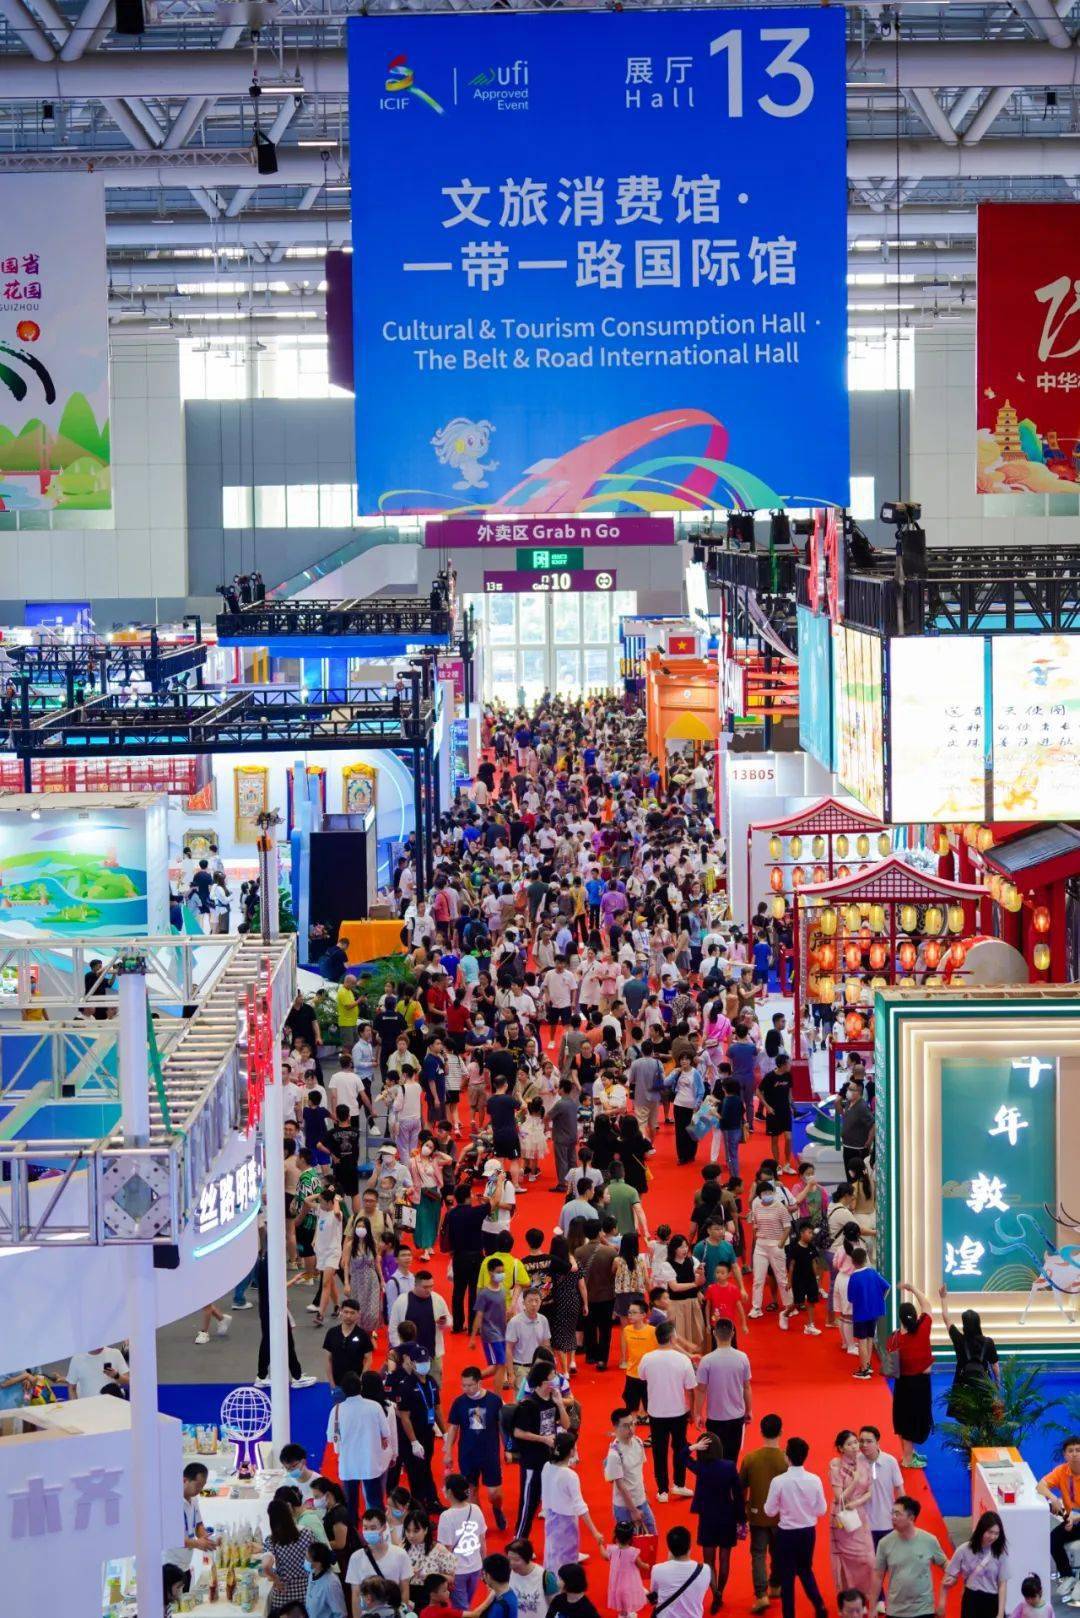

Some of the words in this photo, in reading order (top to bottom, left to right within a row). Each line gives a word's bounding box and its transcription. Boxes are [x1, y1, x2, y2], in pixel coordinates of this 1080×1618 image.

[497, 60, 529, 86] ufi
[625, 56, 693, 84] 展厅
[710, 28, 813, 117] 13
[380, 98, 410, 110] ICIF
[473, 89, 529, 103] Approved
[497, 99, 529, 111] Event
[625, 88, 695, 109] Hall
[403, 235, 797, 292] 一带一路国际馆
[382, 319, 474, 341] Cultural
[479, 319, 496, 340] &
[501, 318, 595, 339] Tourism
[601, 314, 755, 341] Consumption
[762, 311, 806, 335] Hall
[415, 348, 457, 371] The
[463, 348, 507, 370] Belt
[512, 348, 530, 369] &
[536, 346, 593, 369] Road
[600, 342, 749, 367] International
[755, 342, 799, 364] Hall
[1036, 371, 1080, 393] 中华
[477, 524, 529, 541] 外卖区
[532, 524, 576, 539] Grab
[581, 527, 591, 538] n
[595, 523, 620, 538] Go
[551, 573, 571, 590] 10
[733, 769, 775, 781] 13B05
